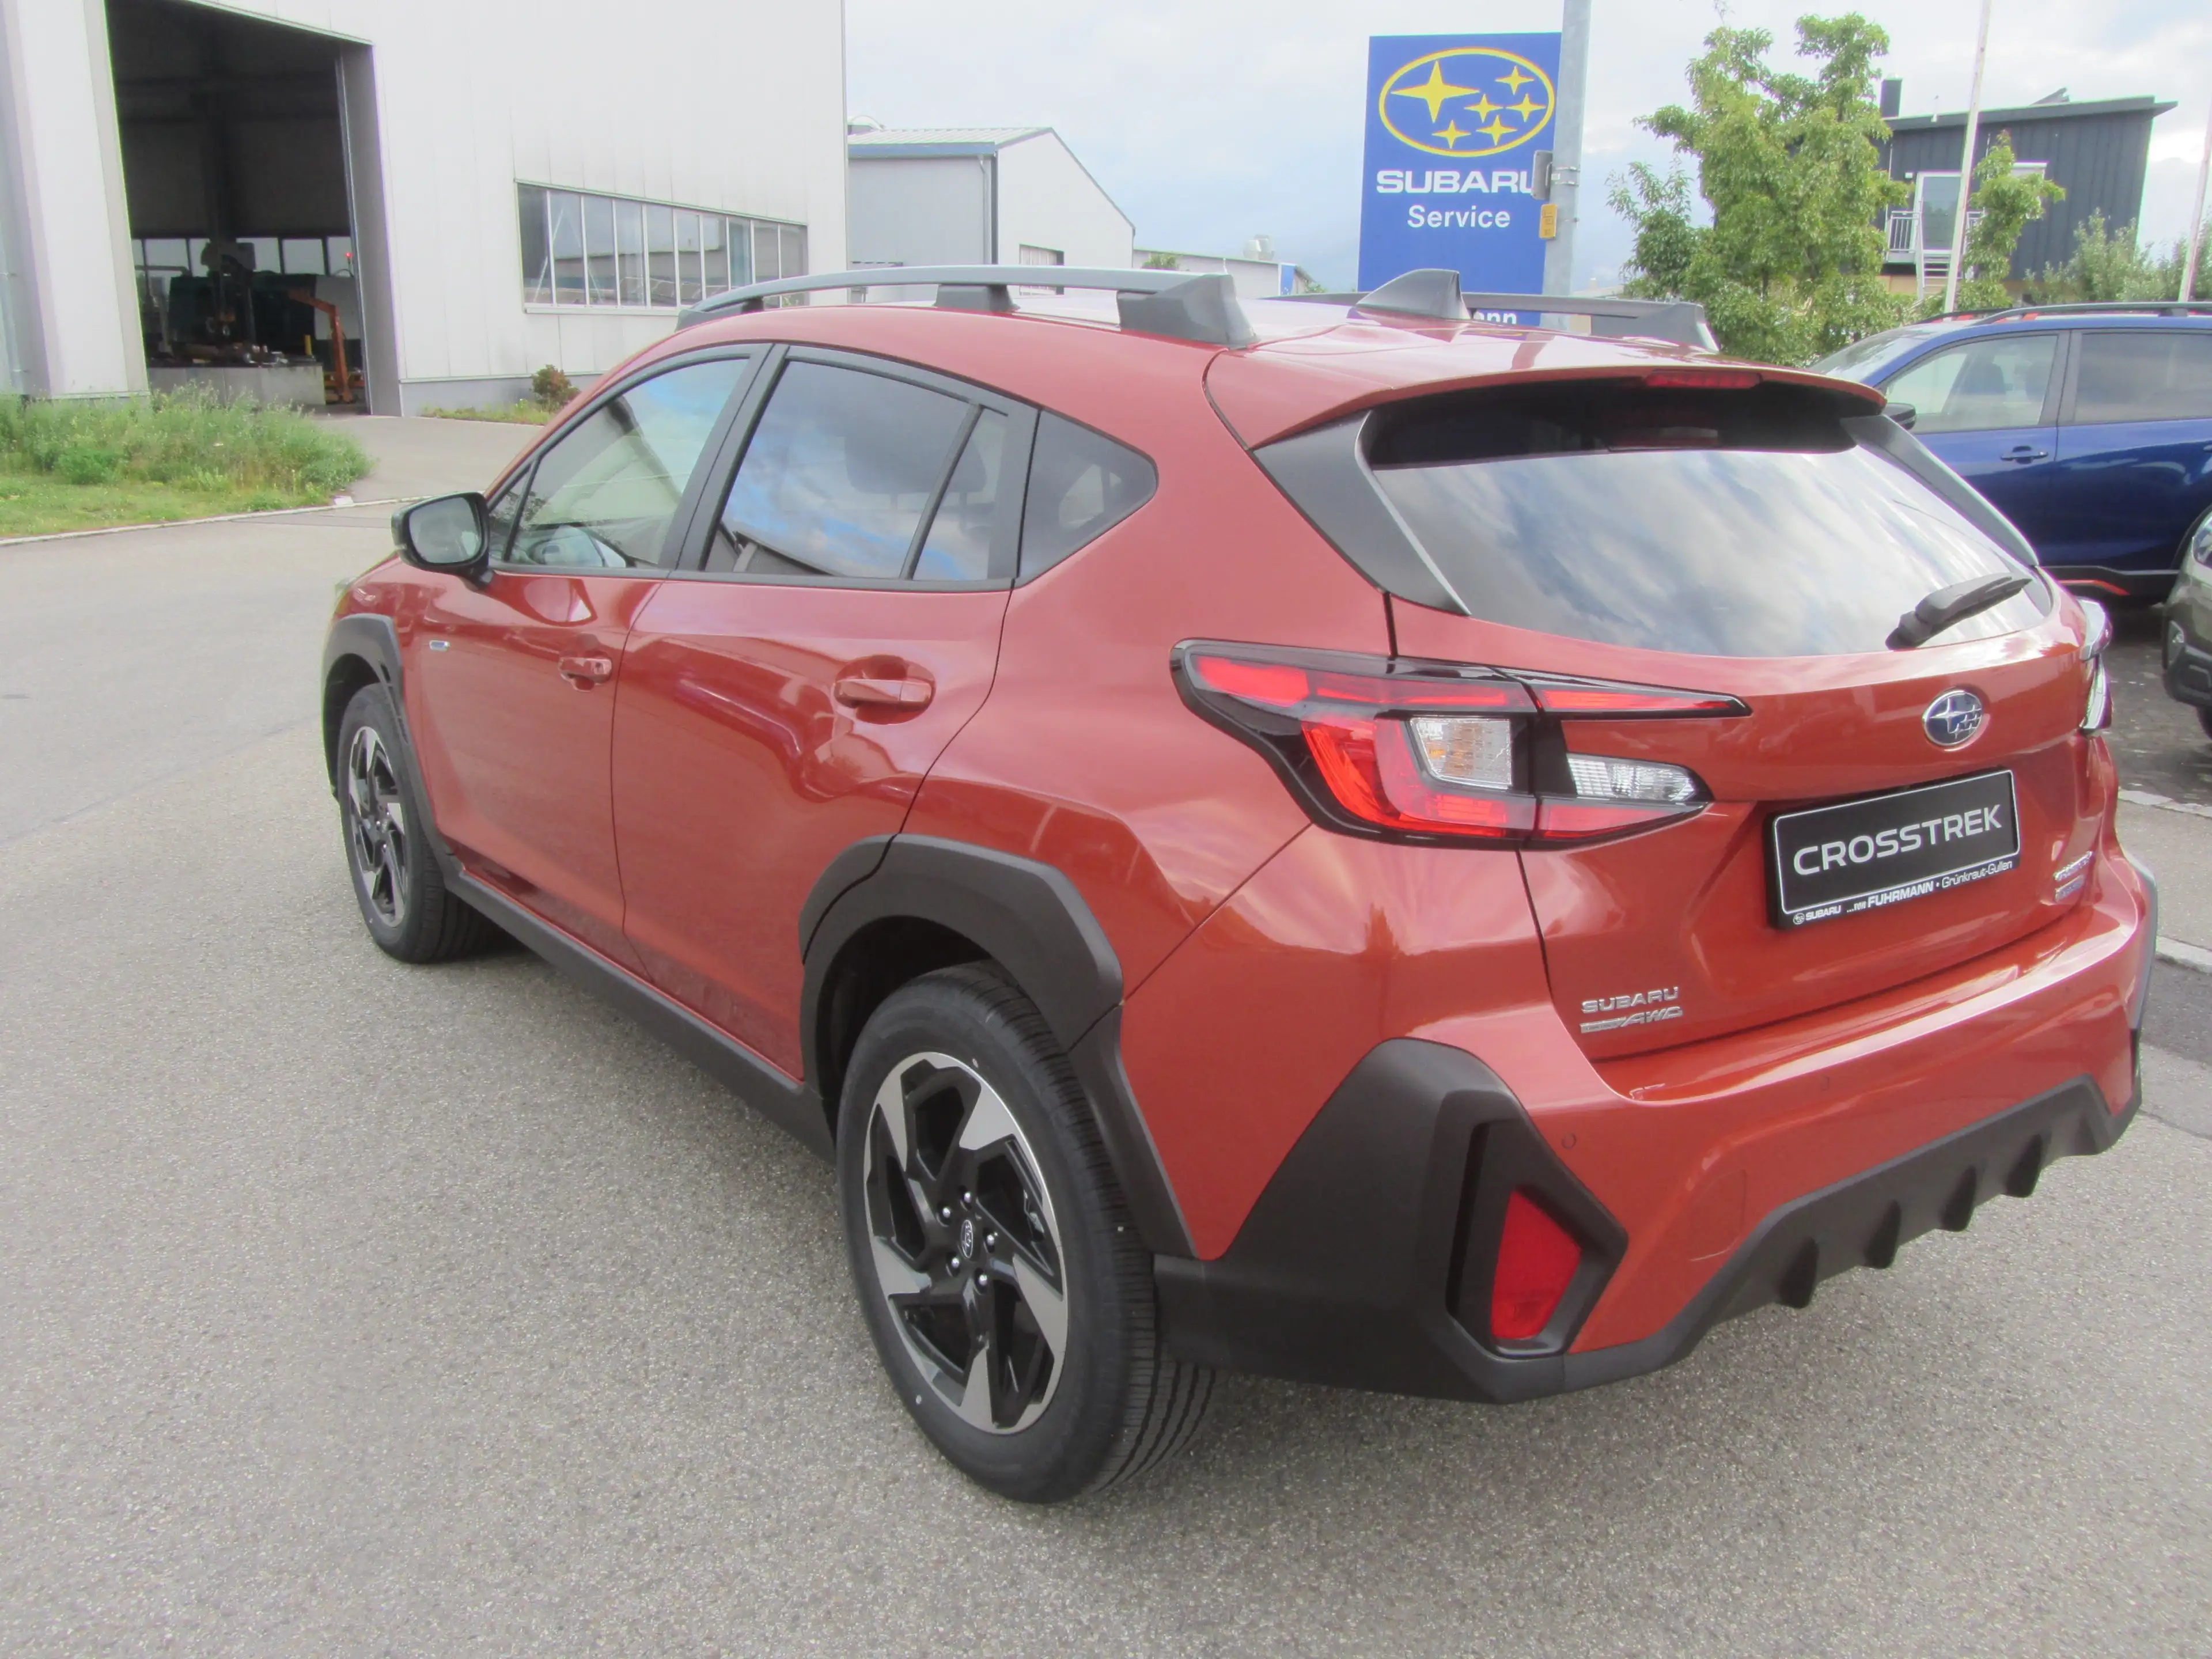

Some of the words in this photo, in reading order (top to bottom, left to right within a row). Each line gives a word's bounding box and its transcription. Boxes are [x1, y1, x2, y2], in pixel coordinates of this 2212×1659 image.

[1407, 205, 1510, 228] Service
[1794, 805, 2002, 876] CROSSTREK
[1806, 905, 1841, 921] SUBARU
[1868, 881, 1934, 908] FUHRMANN
[1582, 987, 1679, 1013] SUBARU
[1620, 1006, 1683, 1027] AWD
